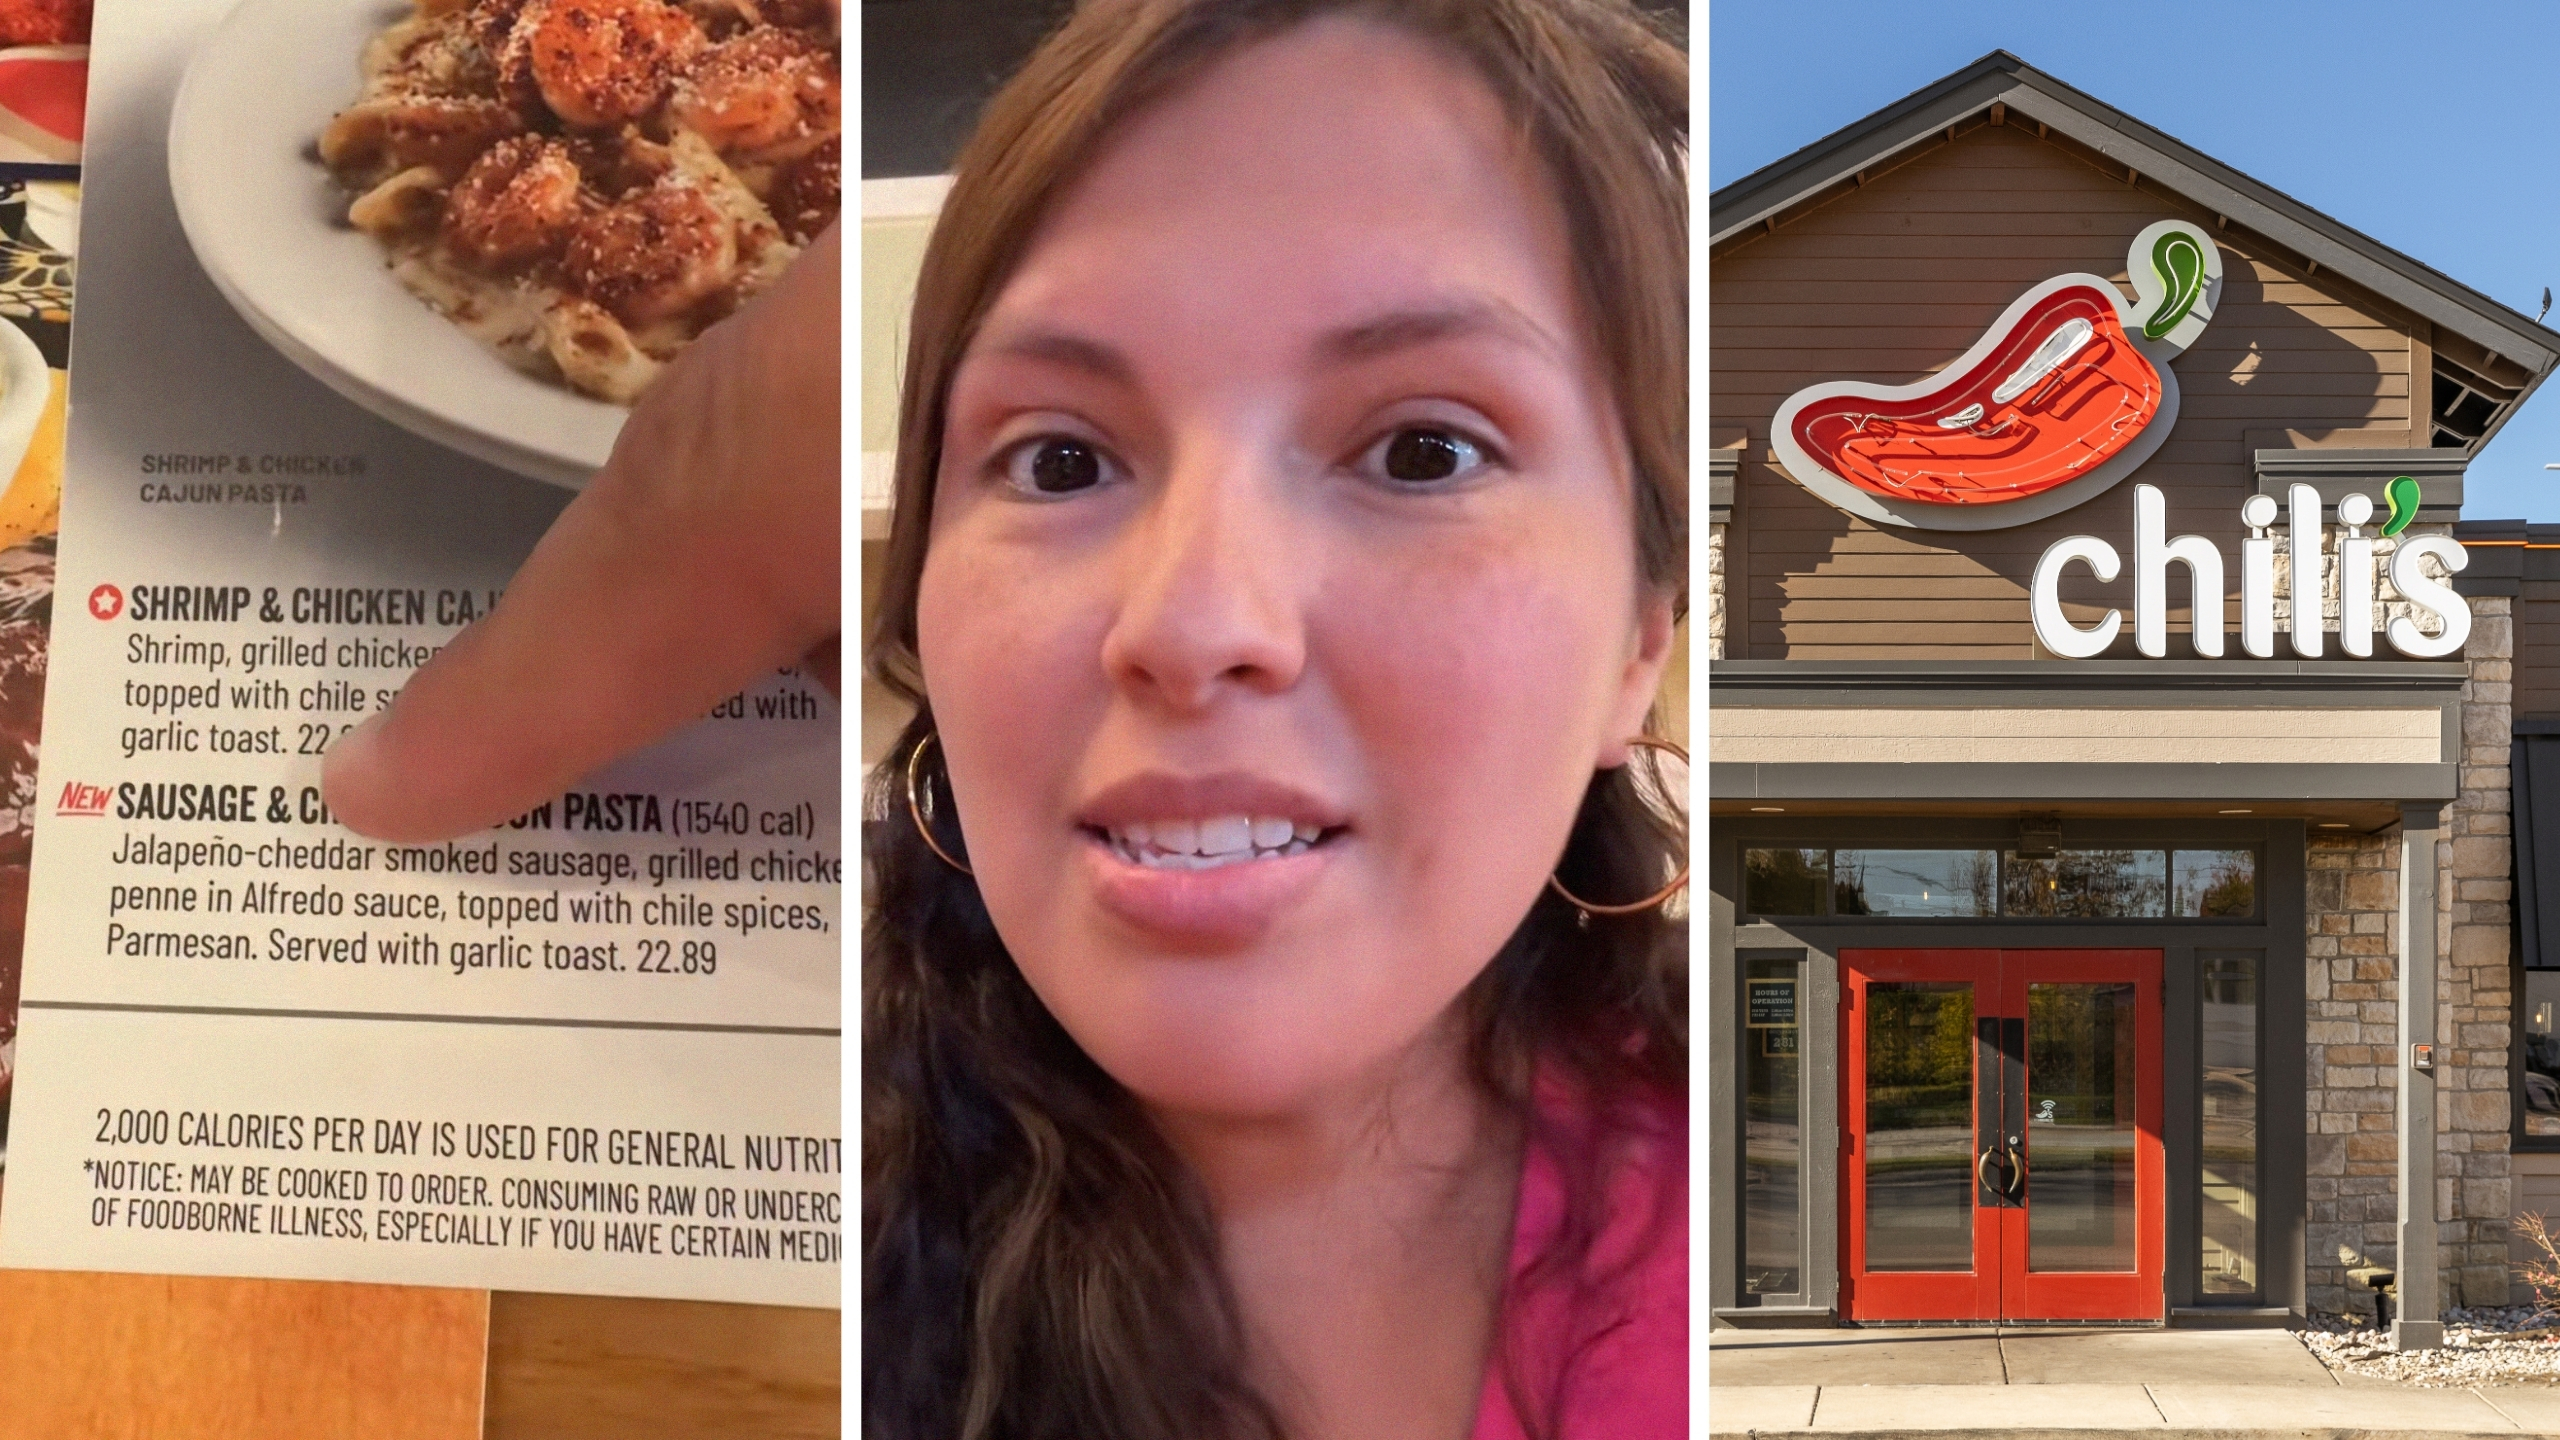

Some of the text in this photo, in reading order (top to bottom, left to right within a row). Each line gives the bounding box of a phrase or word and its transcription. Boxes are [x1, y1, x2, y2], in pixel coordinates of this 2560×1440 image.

[140, 454, 366, 476] SHRIMP & CHICKEN
[139, 483, 307, 504] CAJUN PASTA
[129, 584, 503, 626] SHRIMP & CHICKEN CAJ
[126, 632, 231, 673] Shrimp,
[241, 635, 327, 675] grilled
[124, 678, 220, 716] topped
[230, 679, 290, 711] with
[299, 680, 366, 712] chile
[755, 687, 817, 720] with
[121, 722, 200, 759] garlic
[208, 724, 288, 755] toast.
[56, 781, 114, 817] NEW
[116, 781, 259, 823] SAUSAGE
[265, 785, 293, 824] &
[564, 793, 663, 832] PASTA
[672, 798, 749, 837] (1540
[760, 801, 815, 841] cal)
[111, 832, 376, 874] Jalapeño-cheddar
[384, 842, 498, 875] smoked
[508, 849, 637, 886] sausage,
[648, 847, 739, 888] grilled
[109, 882, 829, 938] penne in Alfredo sauce, topped with chile spices,
[106, 922, 717, 976] Parmesan. Served with garlic toast. 22.89
[1773, 1037, 1794, 1048] 281
[95, 1107, 170, 1147] 2,000
[177, 1111, 305, 1152] CALORIES
[313, 1117, 365, 1154] PER
[374, 1120, 423, 1156] DAY
[432, 1123, 456, 1158] IS
[465, 1125, 536, 1161] USED
[546, 1128, 599, 1164] FOR
[608, 1131, 736, 1170] GENERAL
[190, 1163, 235, 1194] MAY
[241, 1166, 271, 1197] BE
[277, 1167, 368, 1204] COOKED
[375, 1171, 404, 1203] TO
[410, 1173, 493, 1209] ORDER.
[501, 1178, 639, 1216] CONSUMING
[647, 1184, 697, 1217] RAW
[705, 1187, 737, 1219] OR
[91, 1197, 842, 1263] OF FOODBORNE ILLNESS, ESPECIALLY IF YOU HAVE CERTAIN MEDI
